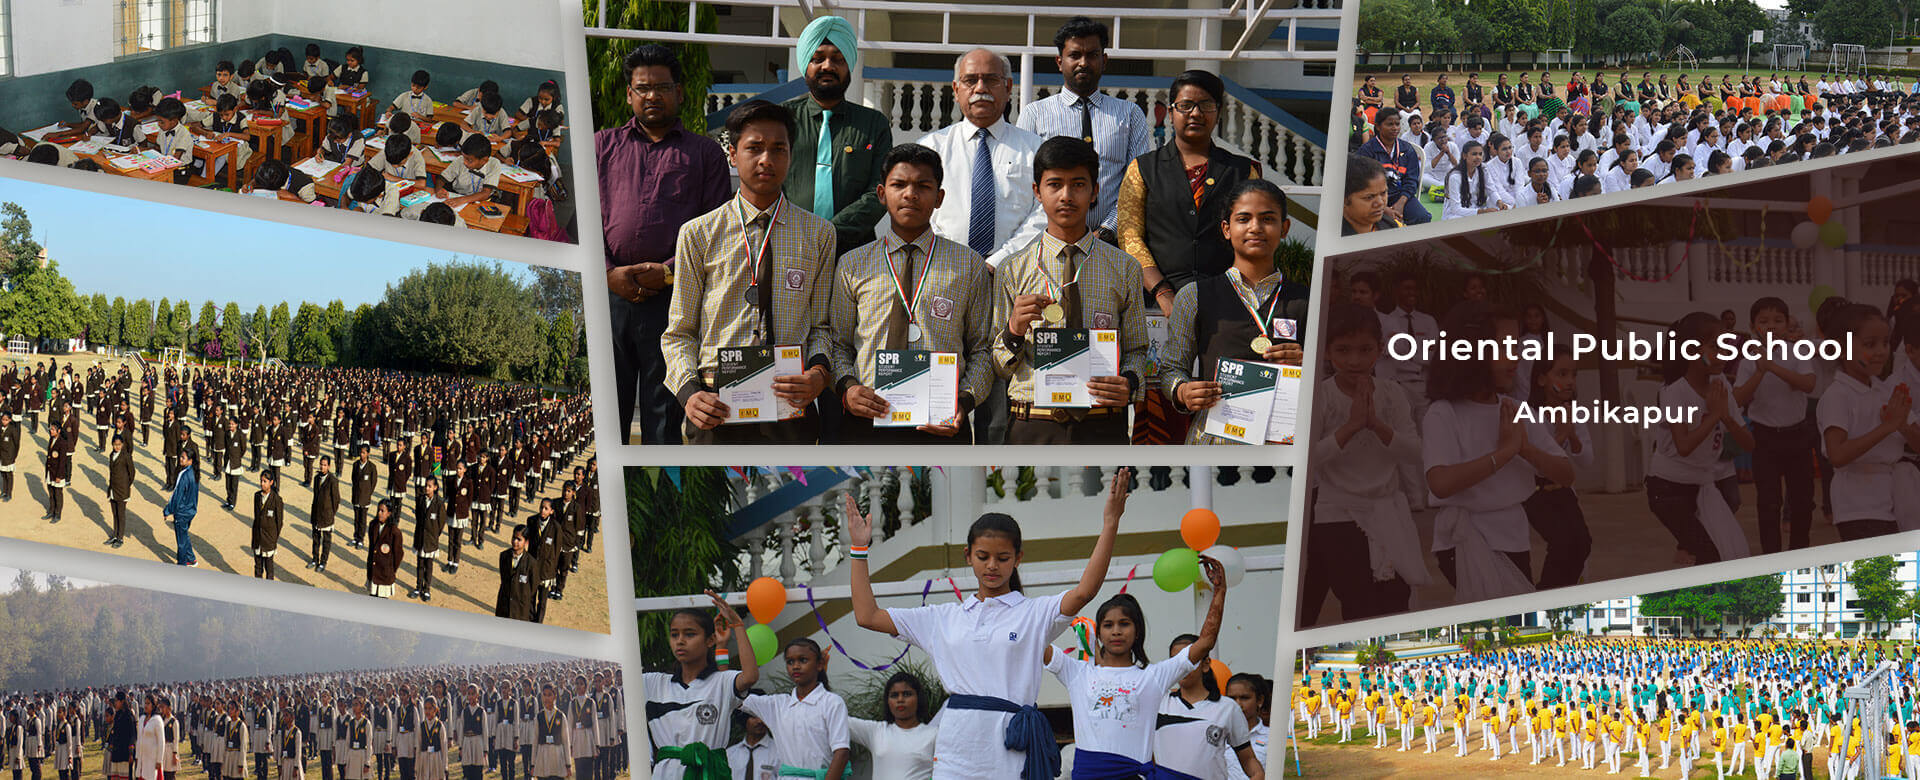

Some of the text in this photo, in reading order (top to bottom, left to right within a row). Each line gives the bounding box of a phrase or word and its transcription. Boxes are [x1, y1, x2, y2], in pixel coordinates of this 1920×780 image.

[1036, 332, 1058, 344] SPR
[720, 350, 743, 362] SPR
[878, 353, 900, 365] SPR
[1221, 361, 1244, 376] SPR
